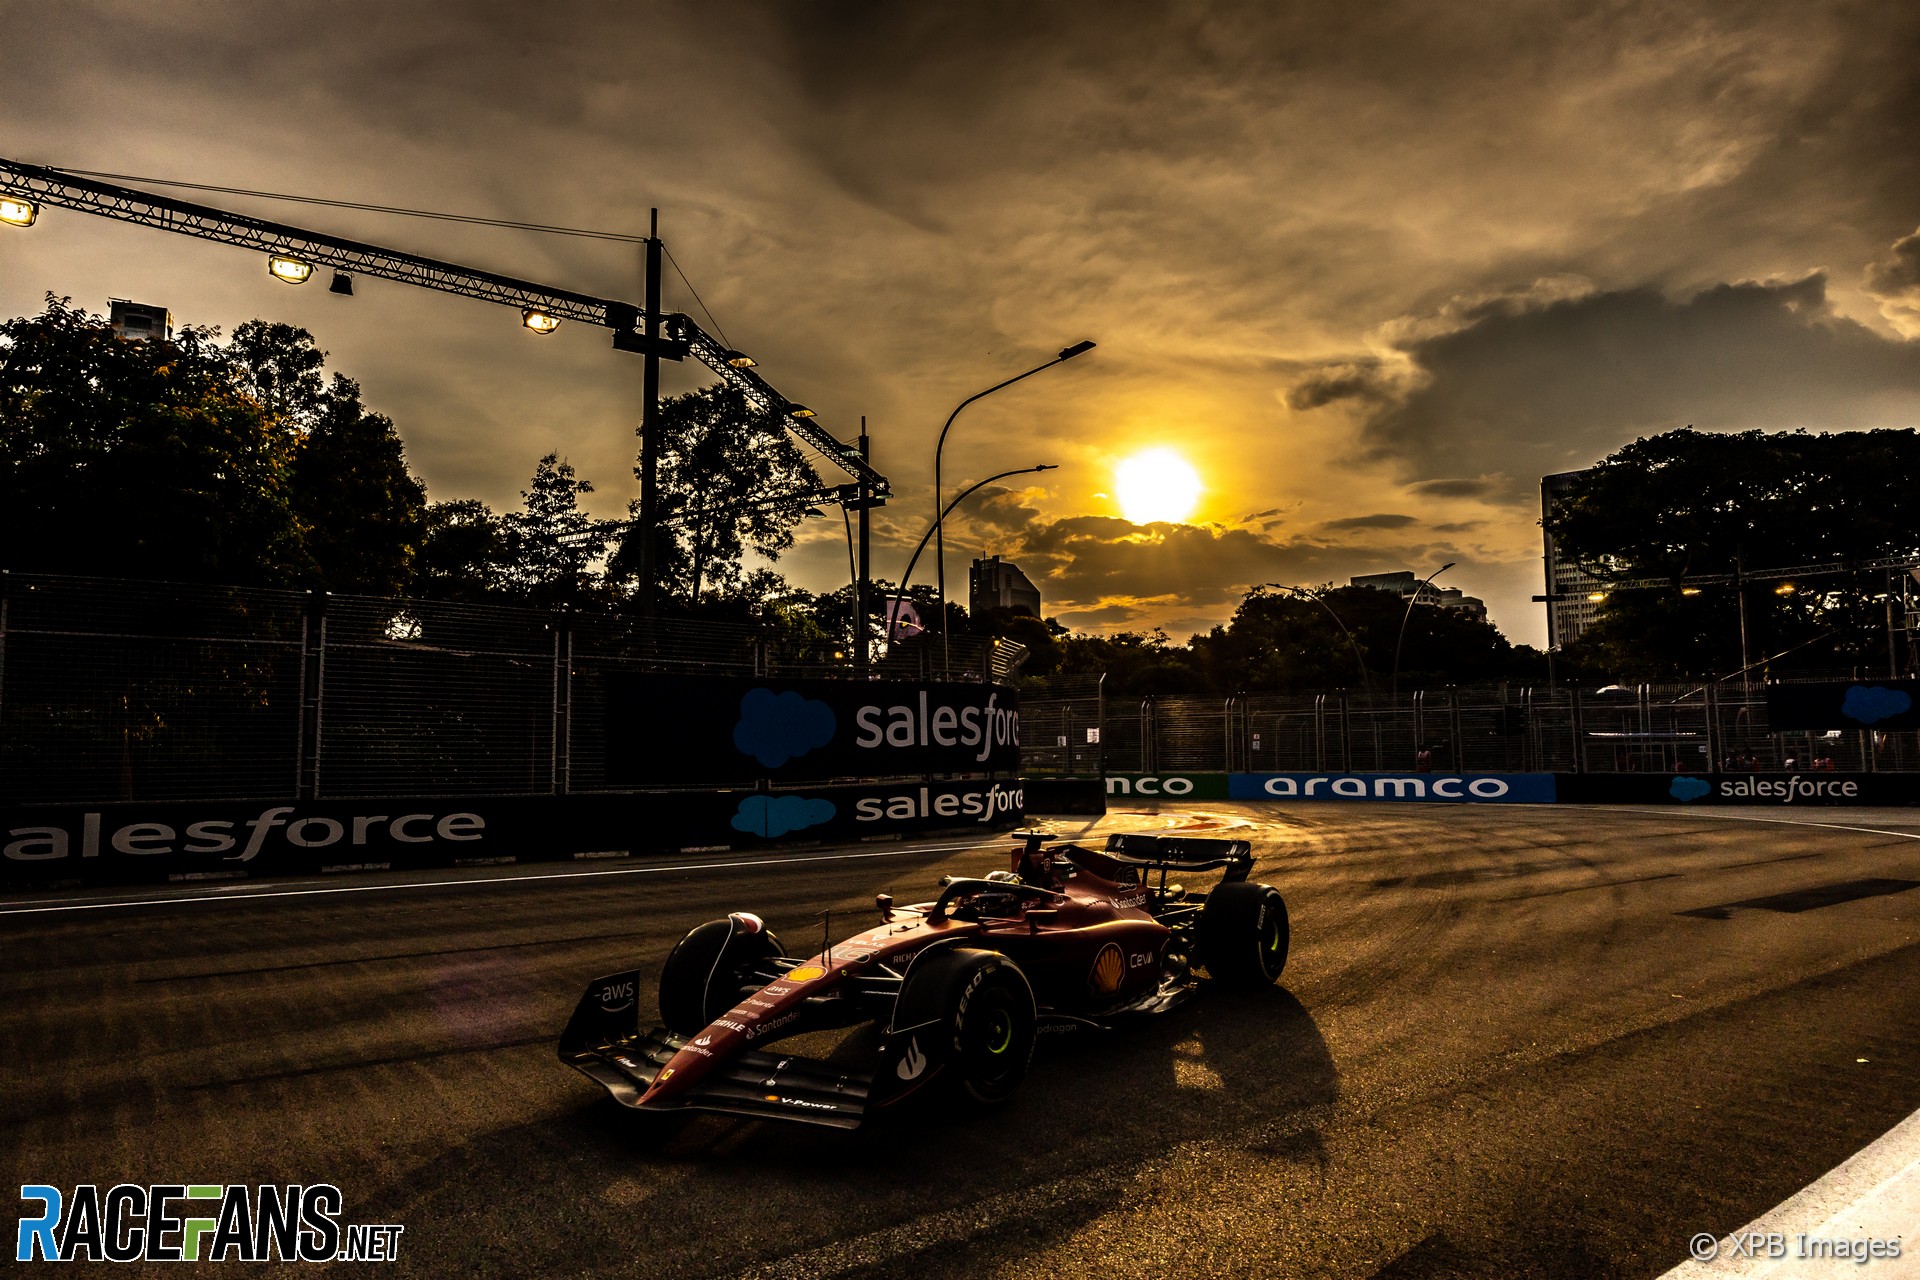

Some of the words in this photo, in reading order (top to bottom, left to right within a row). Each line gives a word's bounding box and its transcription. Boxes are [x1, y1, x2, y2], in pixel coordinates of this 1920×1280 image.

[855, 691, 1020, 762] salesforc
[1263, 777, 1509, 798] aramco
[1720, 775, 1858, 802] salesforce
[856, 783, 1023, 822] salesforc
[602, 981, 634, 1002] aws
[767, 985, 791, 993] aws
[781, 1097, 838, 1109] V-Power
